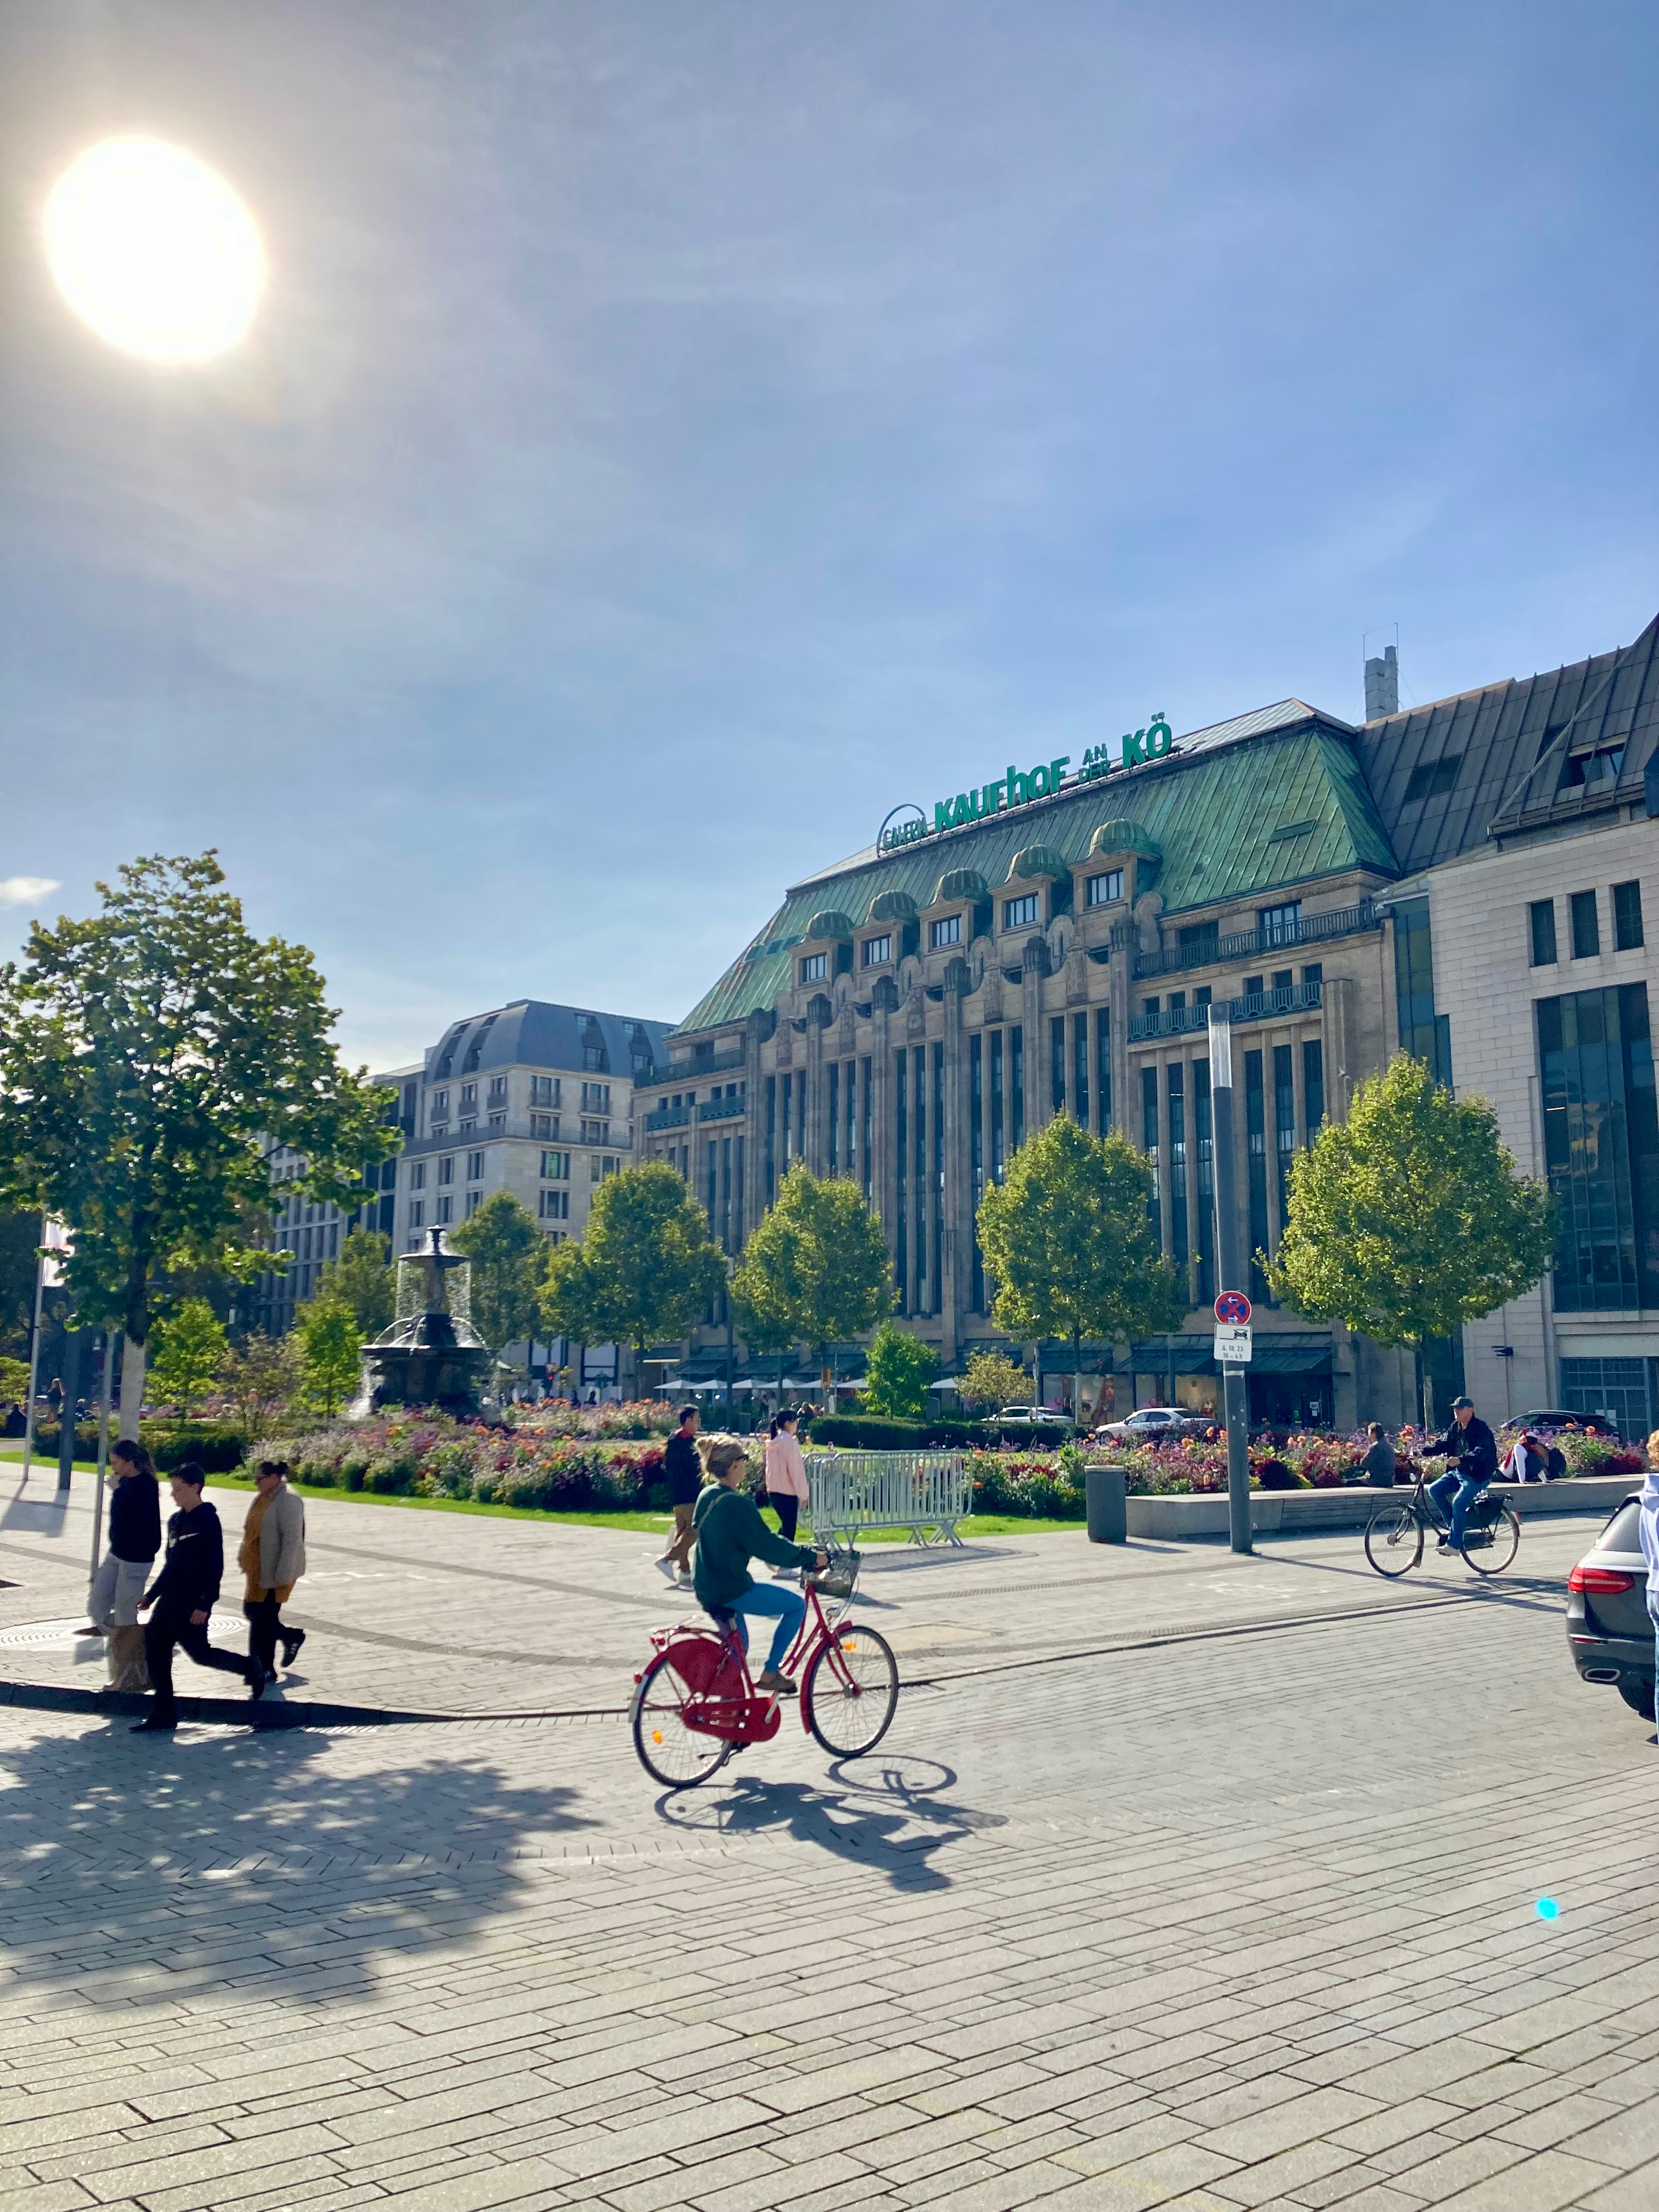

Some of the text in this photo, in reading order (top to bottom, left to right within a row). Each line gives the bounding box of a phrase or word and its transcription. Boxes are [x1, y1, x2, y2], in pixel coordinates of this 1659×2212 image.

[1122, 711, 1172, 769] KÖ
[1082, 743, 1107, 765] AN
[1079, 759, 1111, 783] DER
